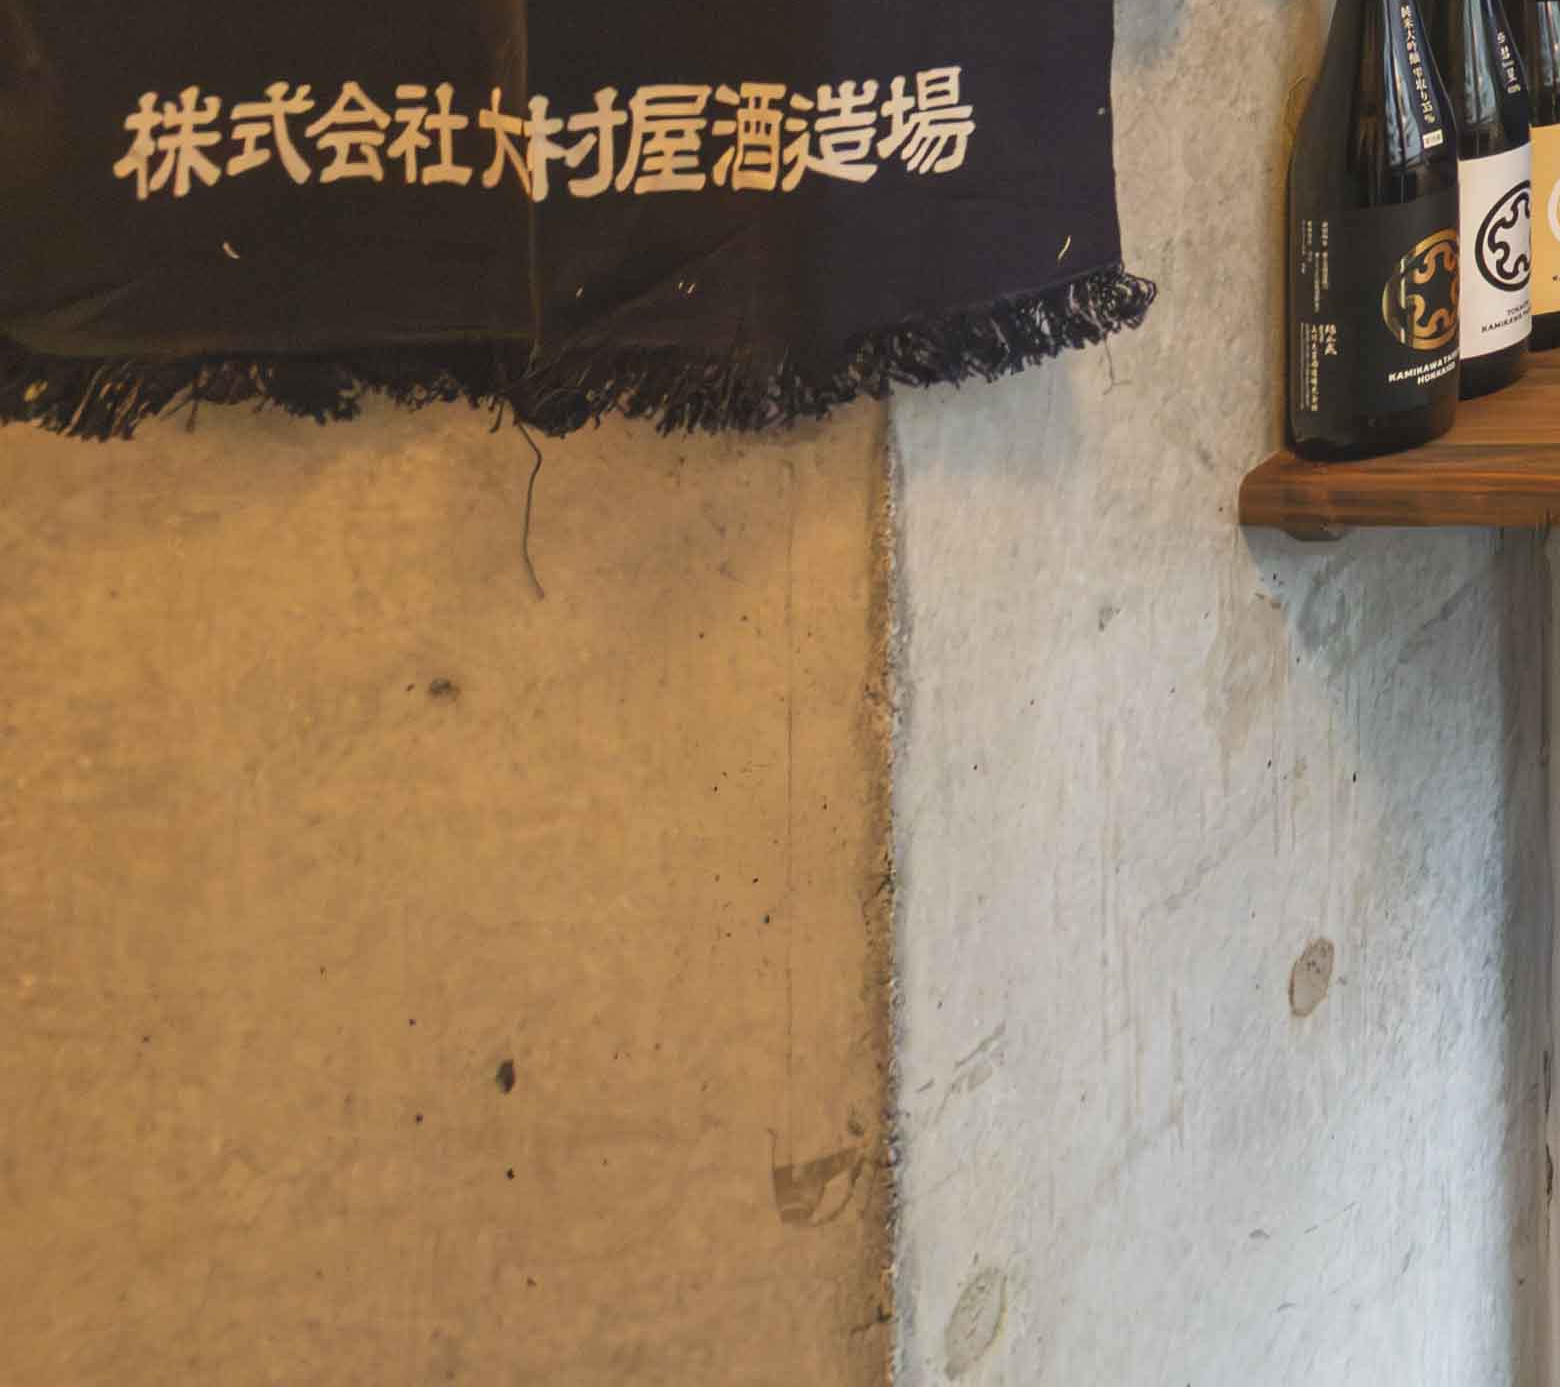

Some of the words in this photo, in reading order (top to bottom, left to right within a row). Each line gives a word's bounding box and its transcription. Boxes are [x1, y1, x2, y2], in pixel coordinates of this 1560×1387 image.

[114, 64, 975, 203] 株式会社大村屋酒造場
[1388, 359, 1443, 384] KAMIKAWA
